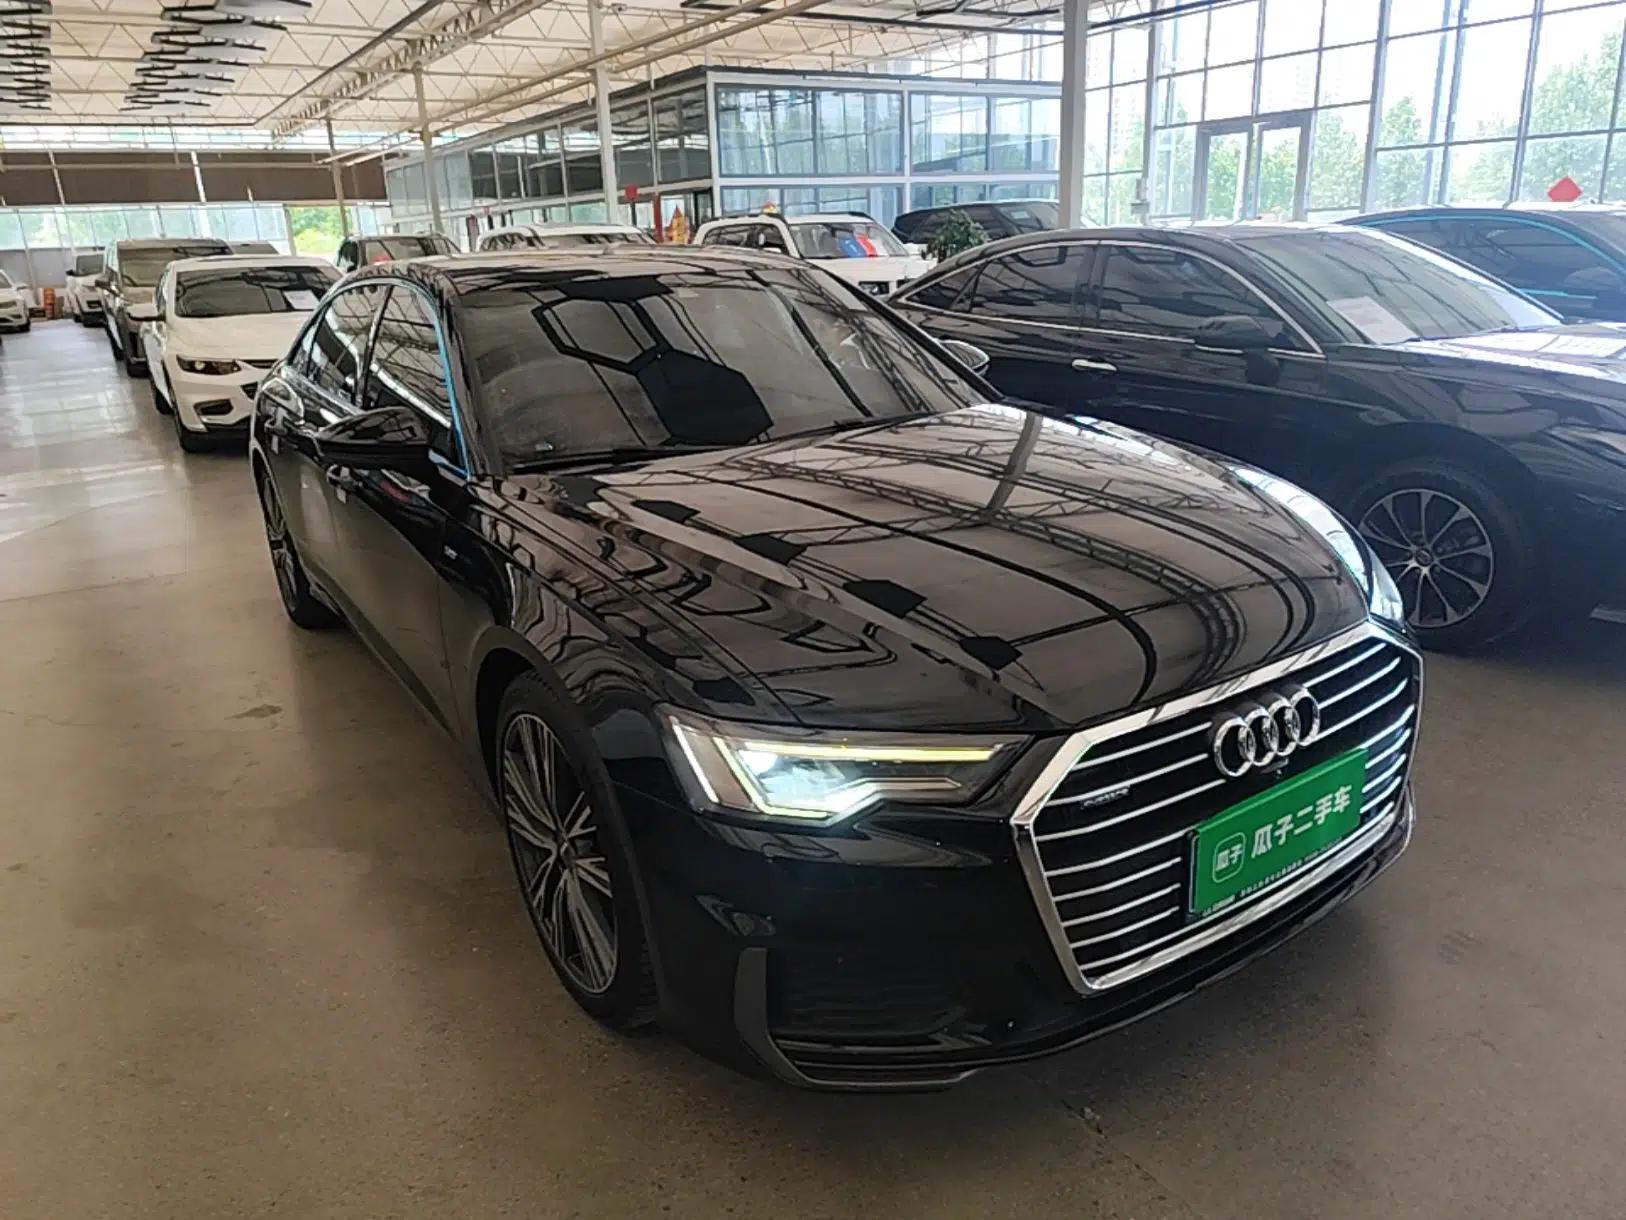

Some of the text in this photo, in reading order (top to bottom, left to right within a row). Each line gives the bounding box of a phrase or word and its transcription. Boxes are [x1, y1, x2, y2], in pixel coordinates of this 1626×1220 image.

[1250, 785, 1352, 858] 瓜子二手车
